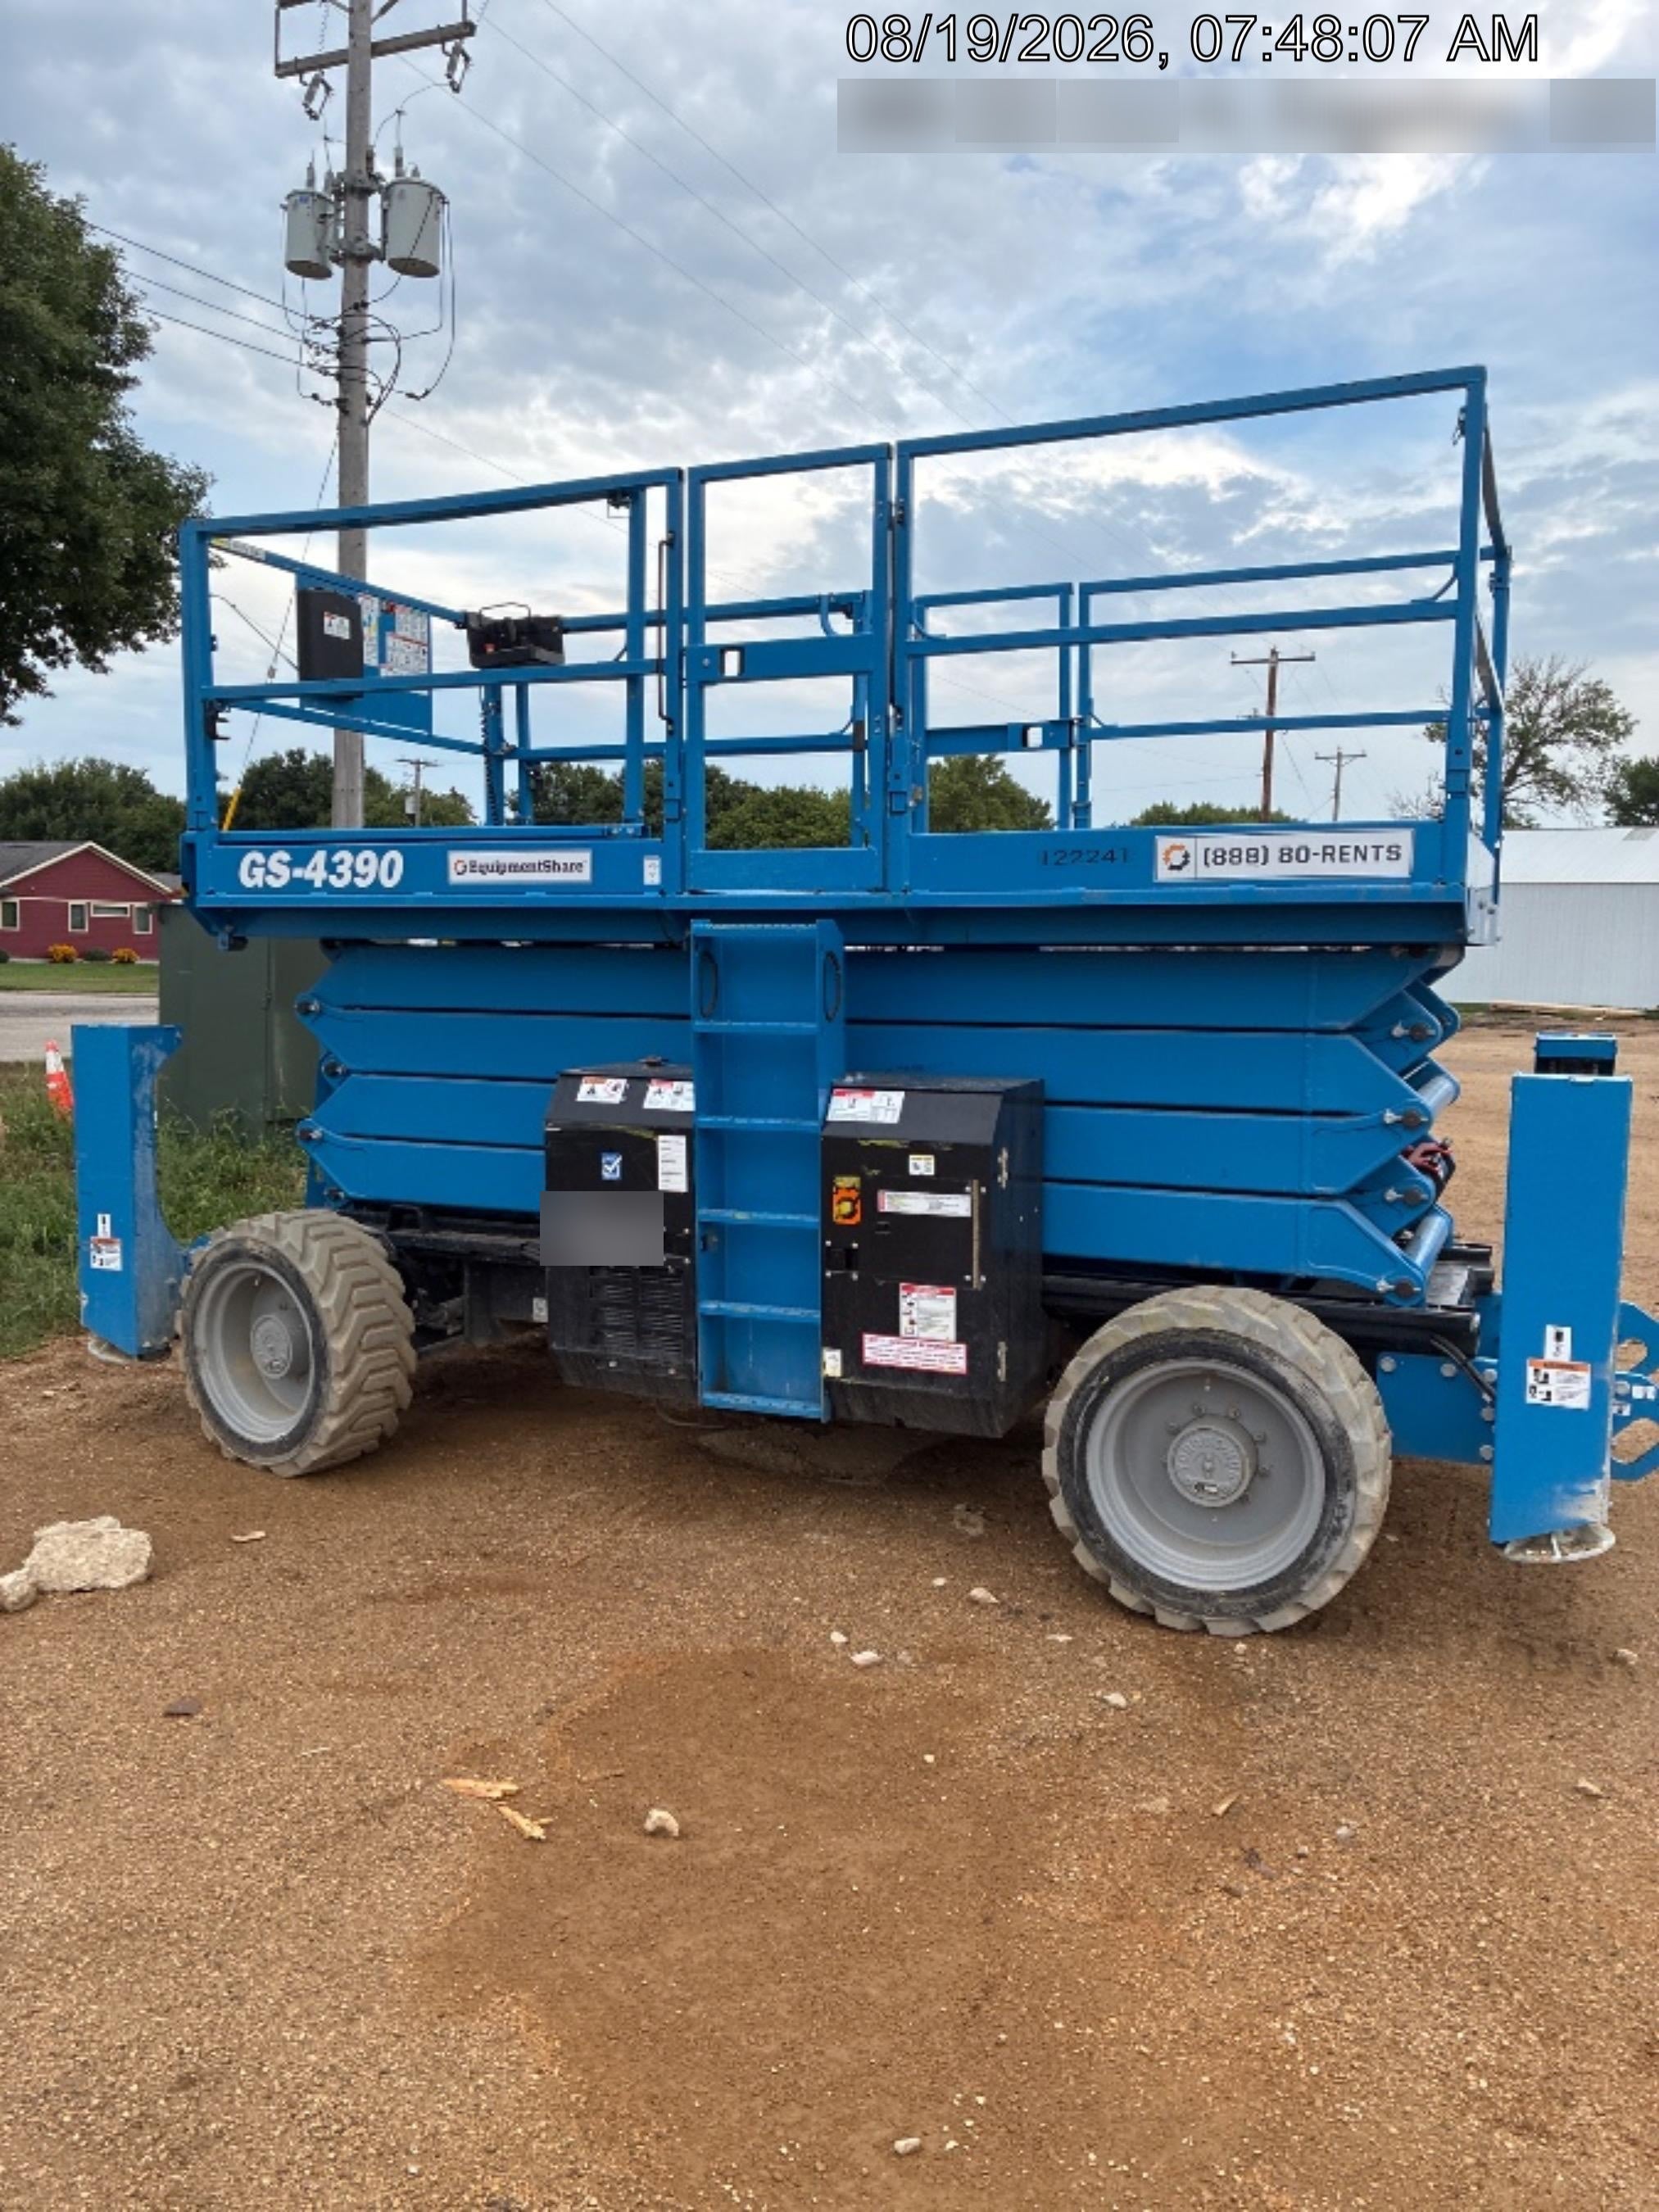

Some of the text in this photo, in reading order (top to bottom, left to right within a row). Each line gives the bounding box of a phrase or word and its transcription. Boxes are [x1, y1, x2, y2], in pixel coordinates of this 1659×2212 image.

[469, 859, 583, 875] EquipmentShare
[1203, 844, 1402, 868] (888) 80-RENTS
[238, 850, 405, 889] GS-4390
